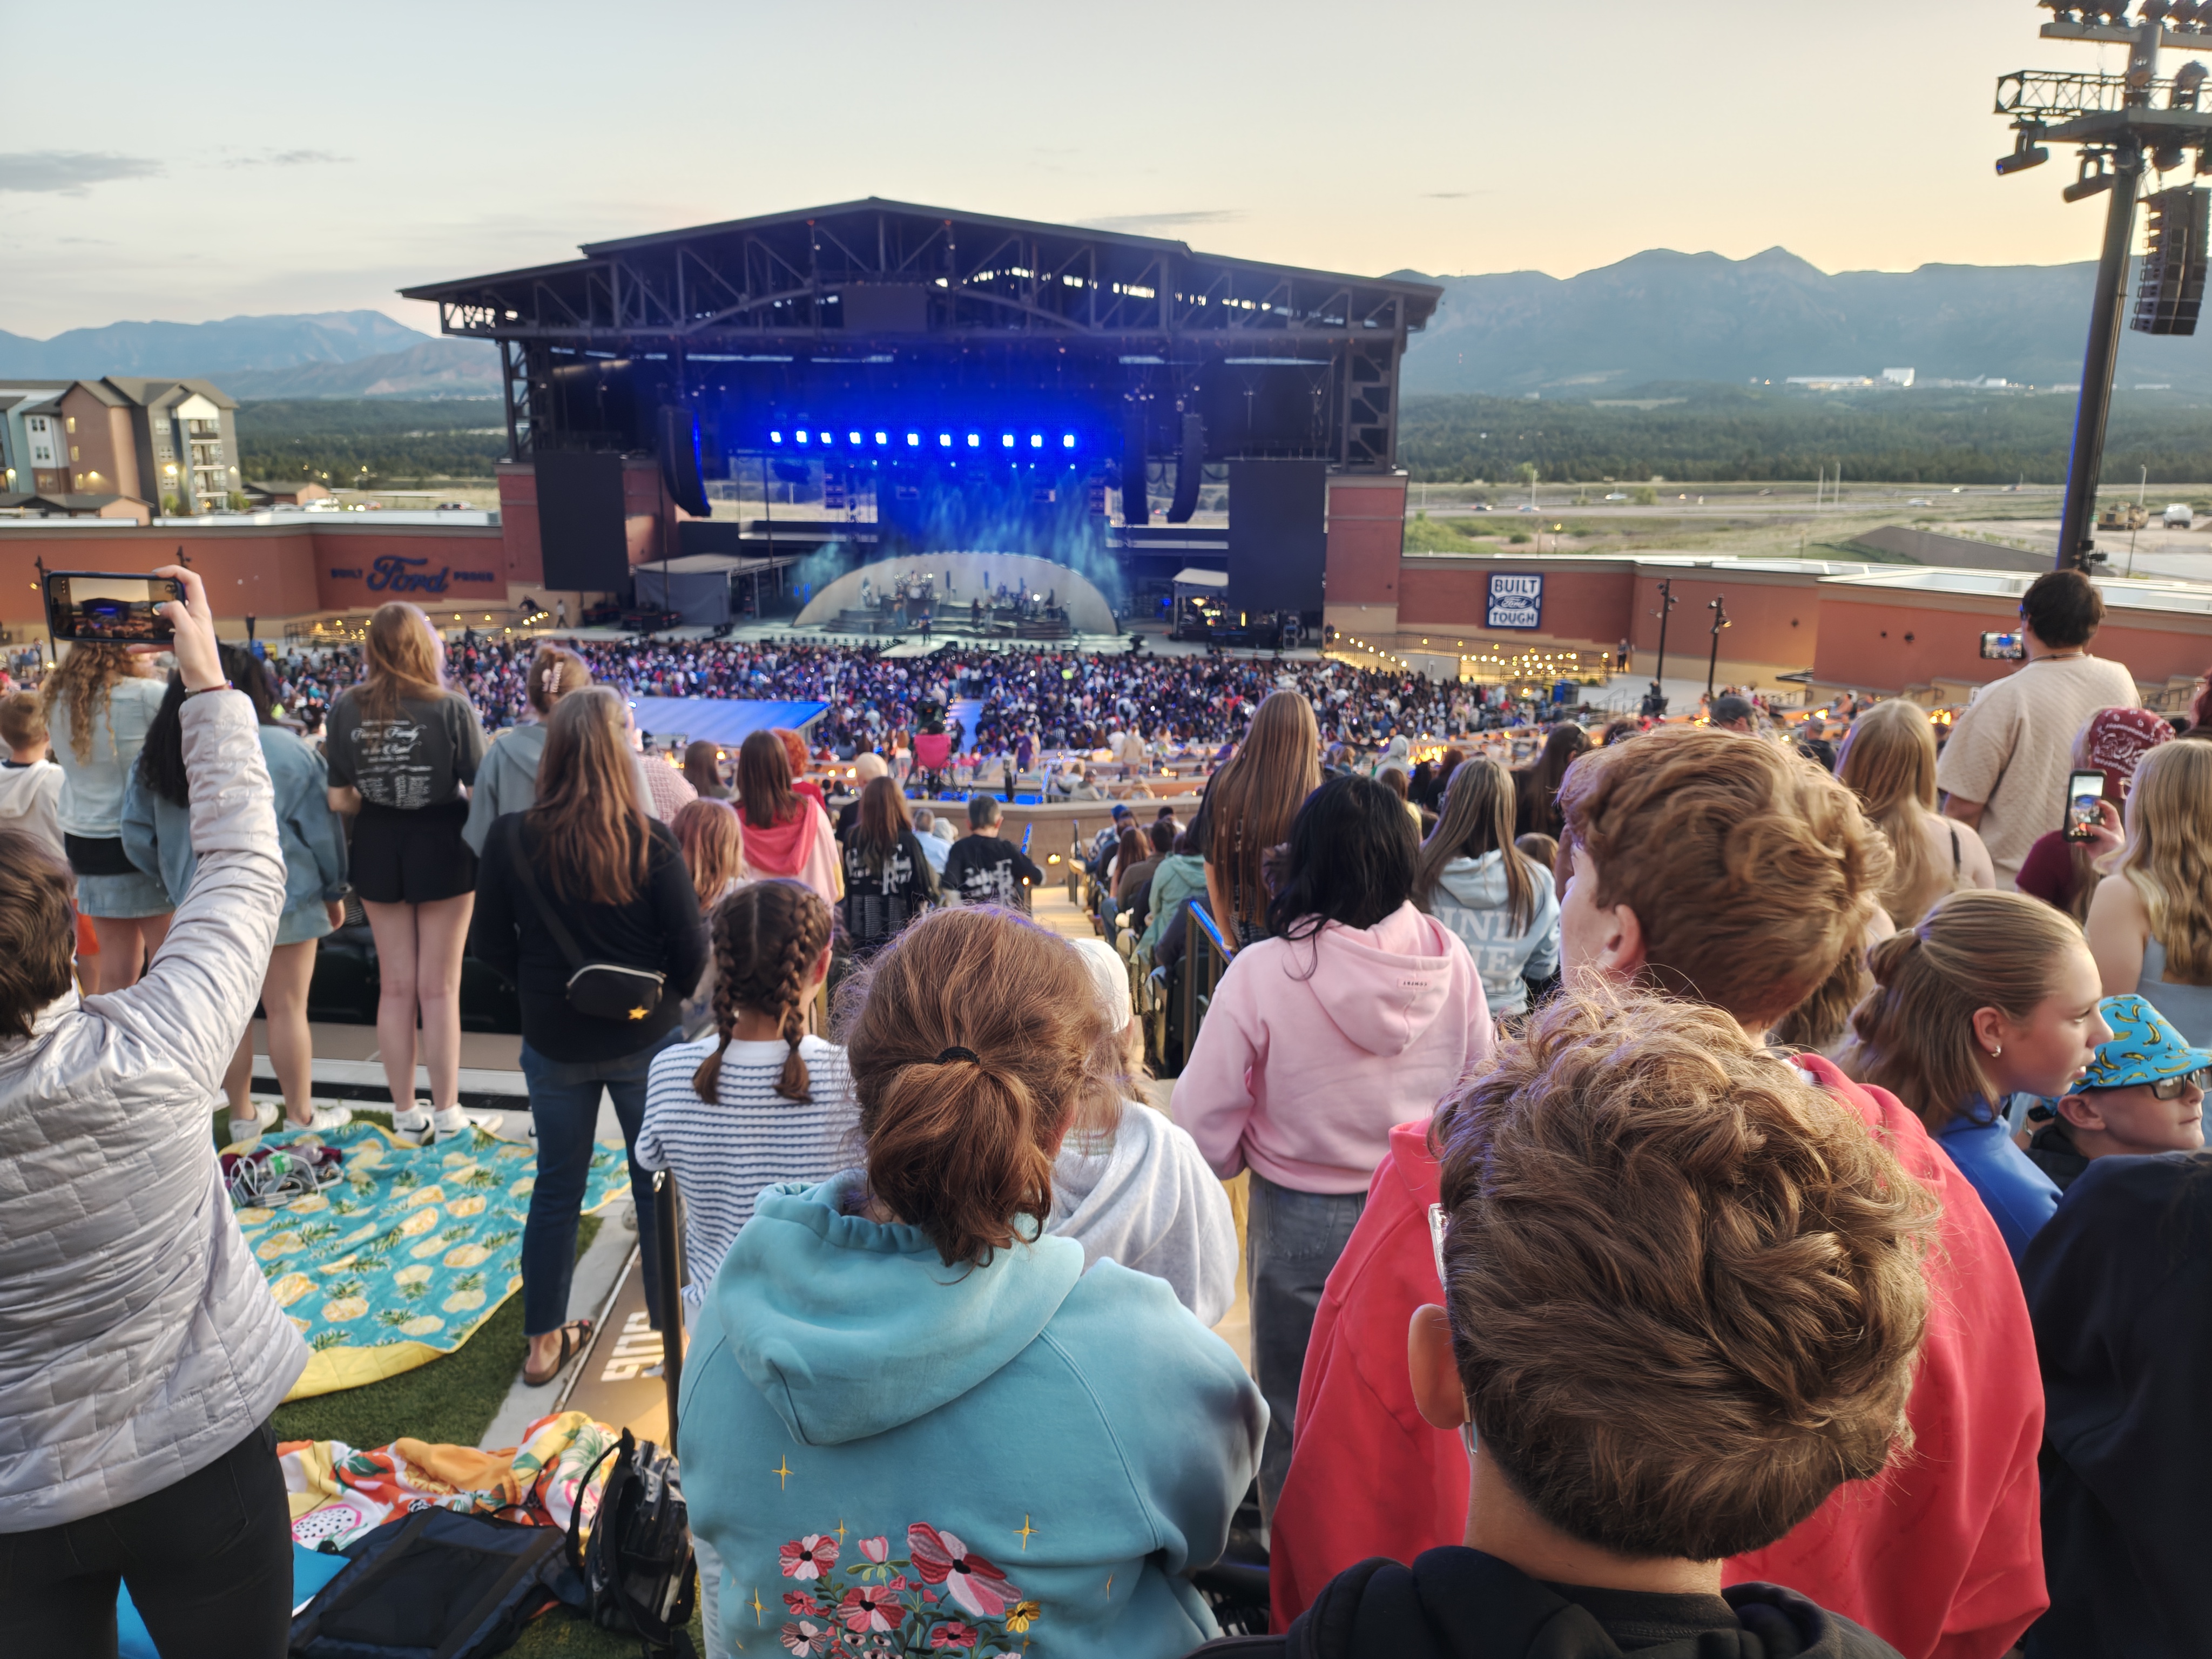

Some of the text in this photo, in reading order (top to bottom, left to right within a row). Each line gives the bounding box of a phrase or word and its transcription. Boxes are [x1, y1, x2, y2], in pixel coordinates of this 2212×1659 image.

[367, 555, 449, 592] Ford
[1495, 579, 1537, 593] BUILT
[1501, 596, 1528, 608] Ford
[1493, 612, 1534, 624] TOUGH
